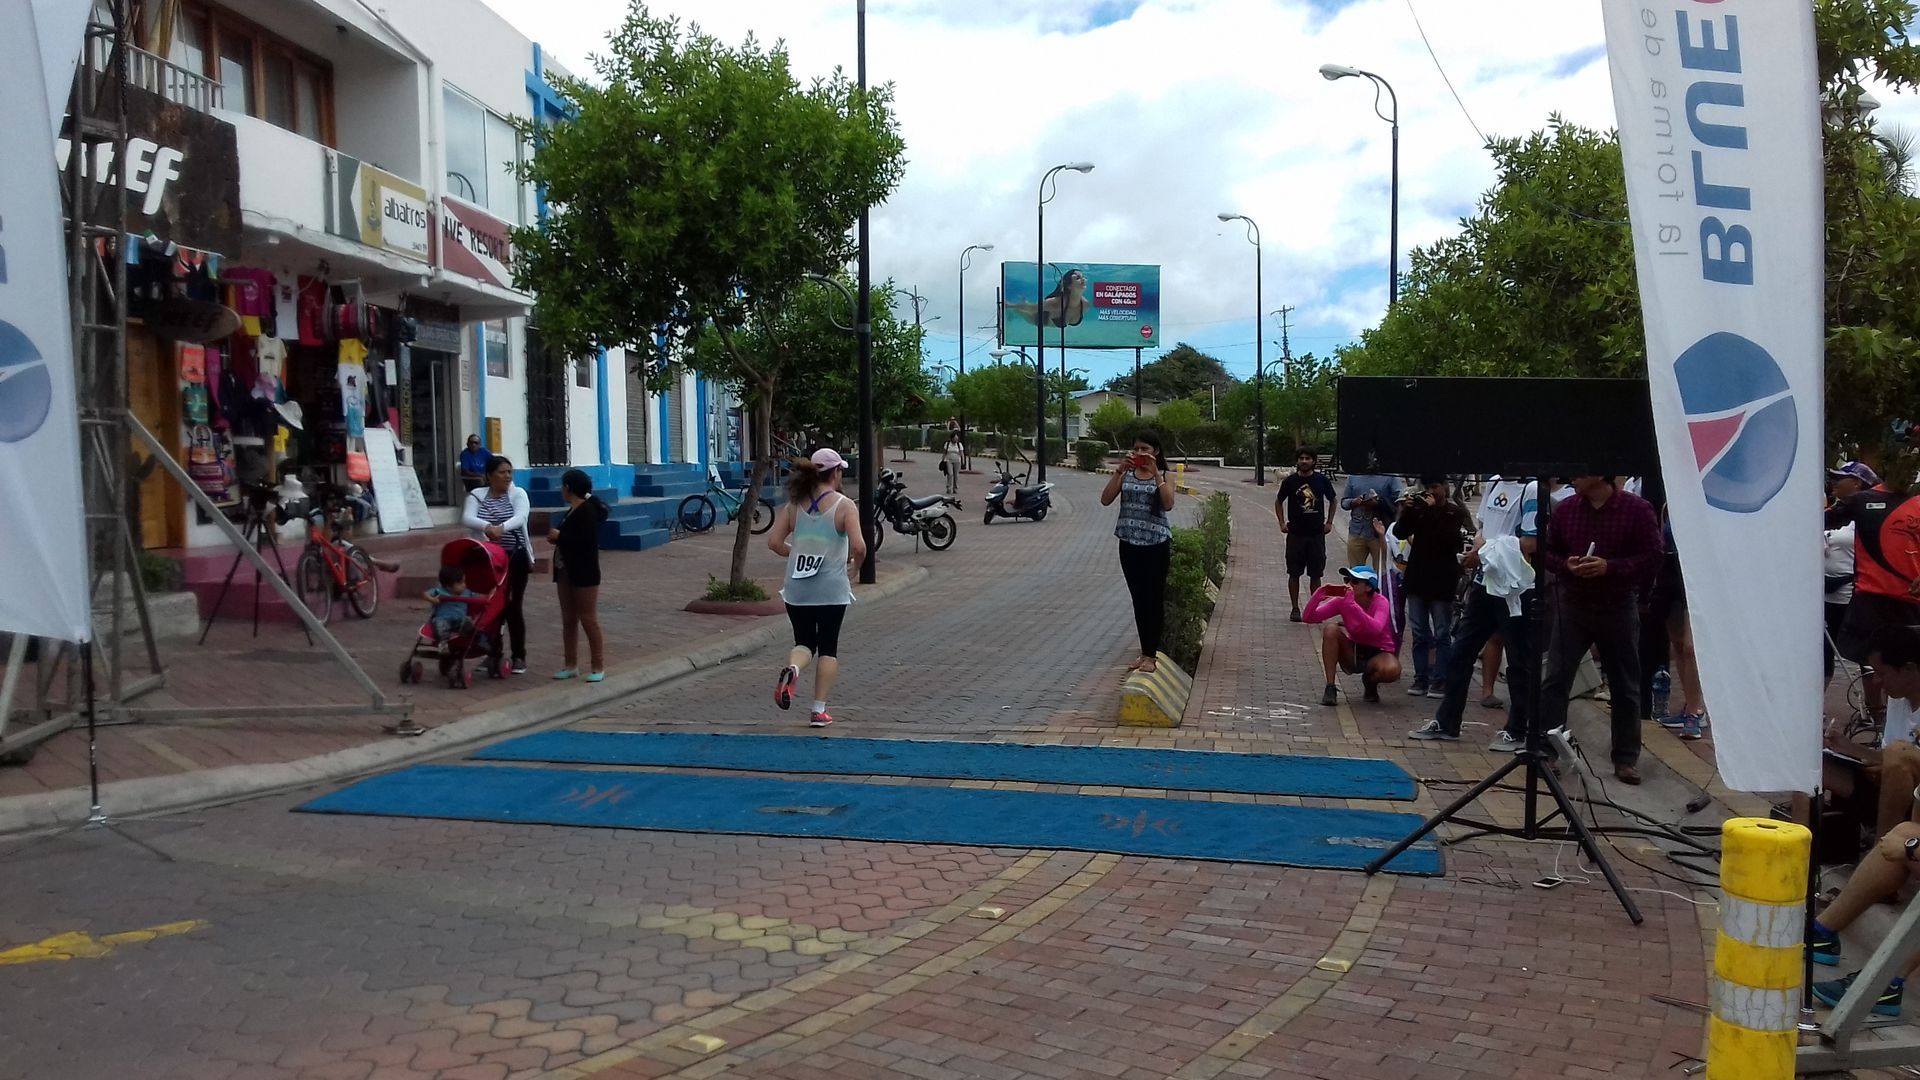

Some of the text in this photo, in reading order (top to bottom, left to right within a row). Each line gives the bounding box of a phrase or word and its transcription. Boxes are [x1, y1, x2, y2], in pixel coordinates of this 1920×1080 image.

[384, 197, 426, 229] albatros
[442, 216, 504, 261] IVE RESORT
[796, 554, 823, 572] 094
